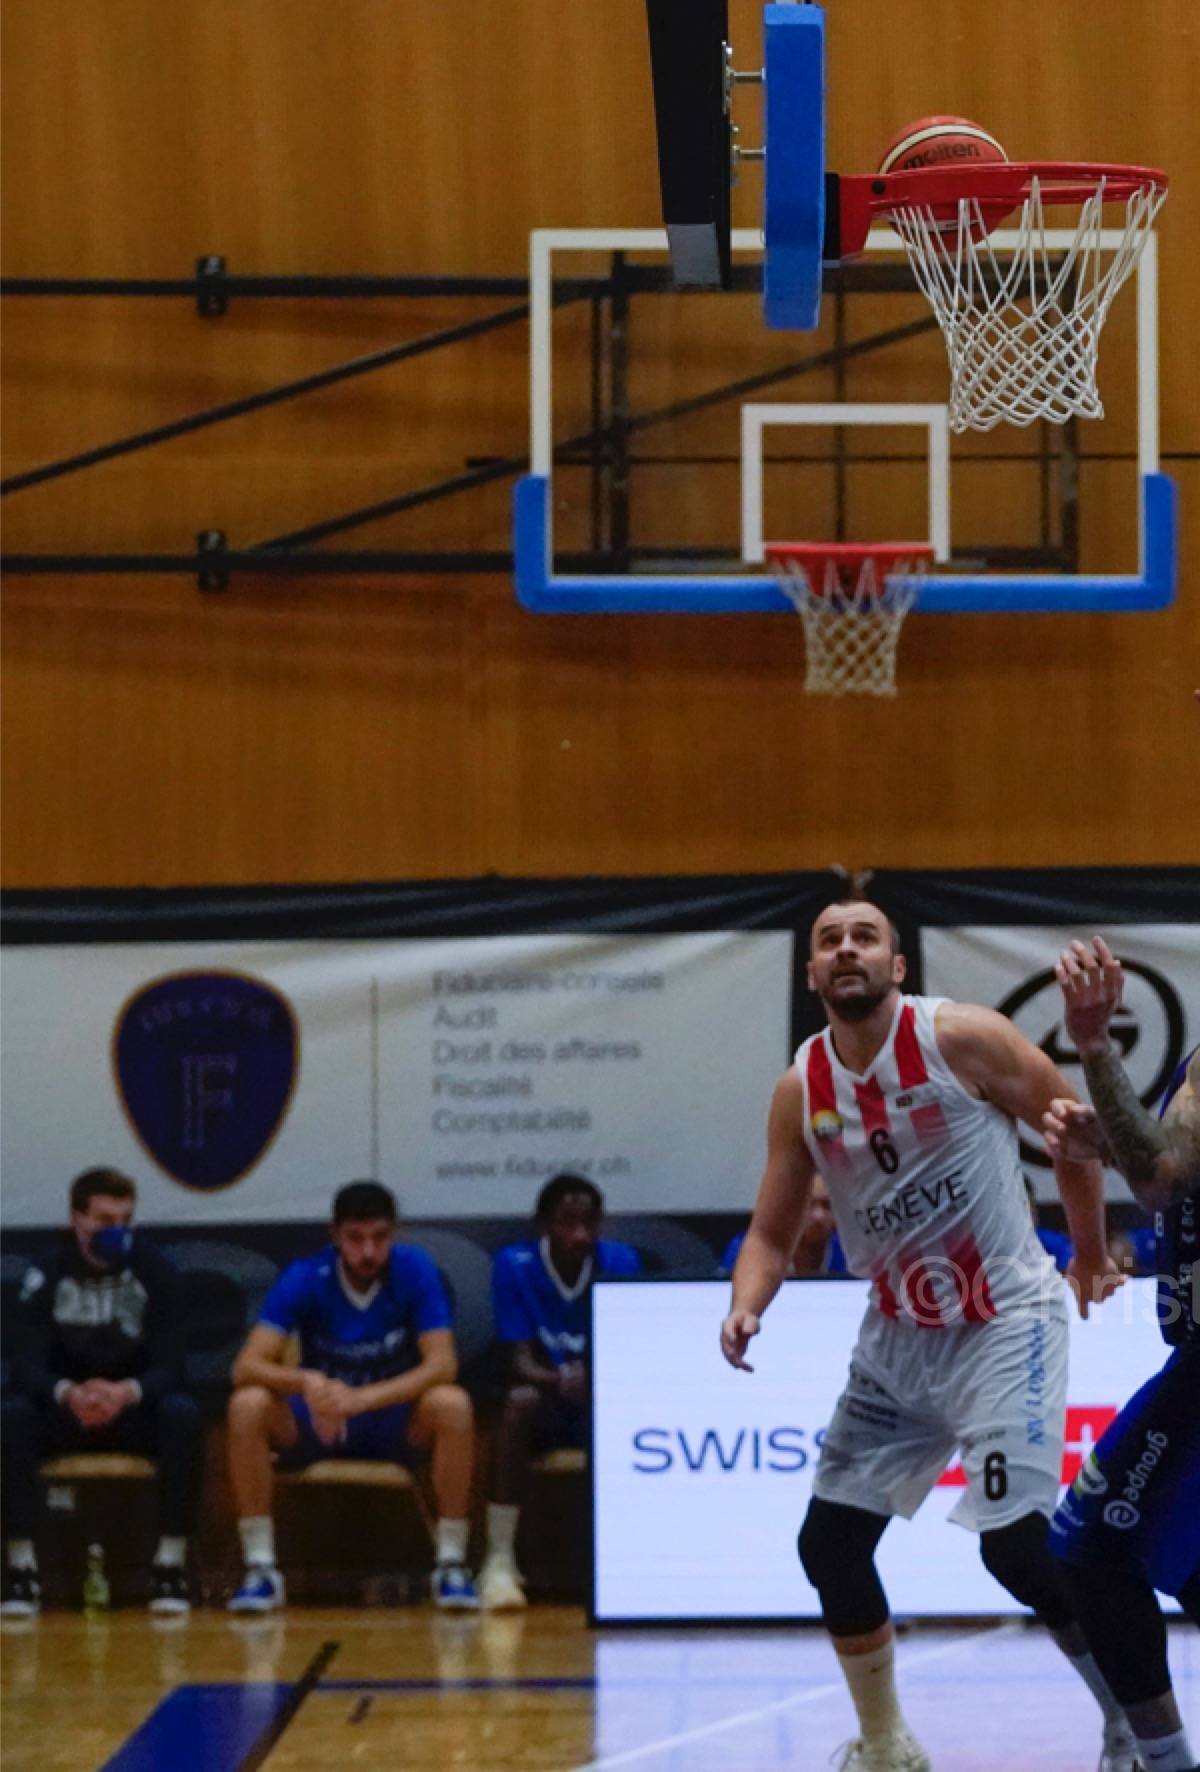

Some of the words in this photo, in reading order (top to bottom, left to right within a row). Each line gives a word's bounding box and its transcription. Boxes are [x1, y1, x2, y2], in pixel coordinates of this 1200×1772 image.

[903, 143, 981, 169] molten
[869, 1127, 899, 1175] 6
[984, 1451, 1007, 1502] 6
